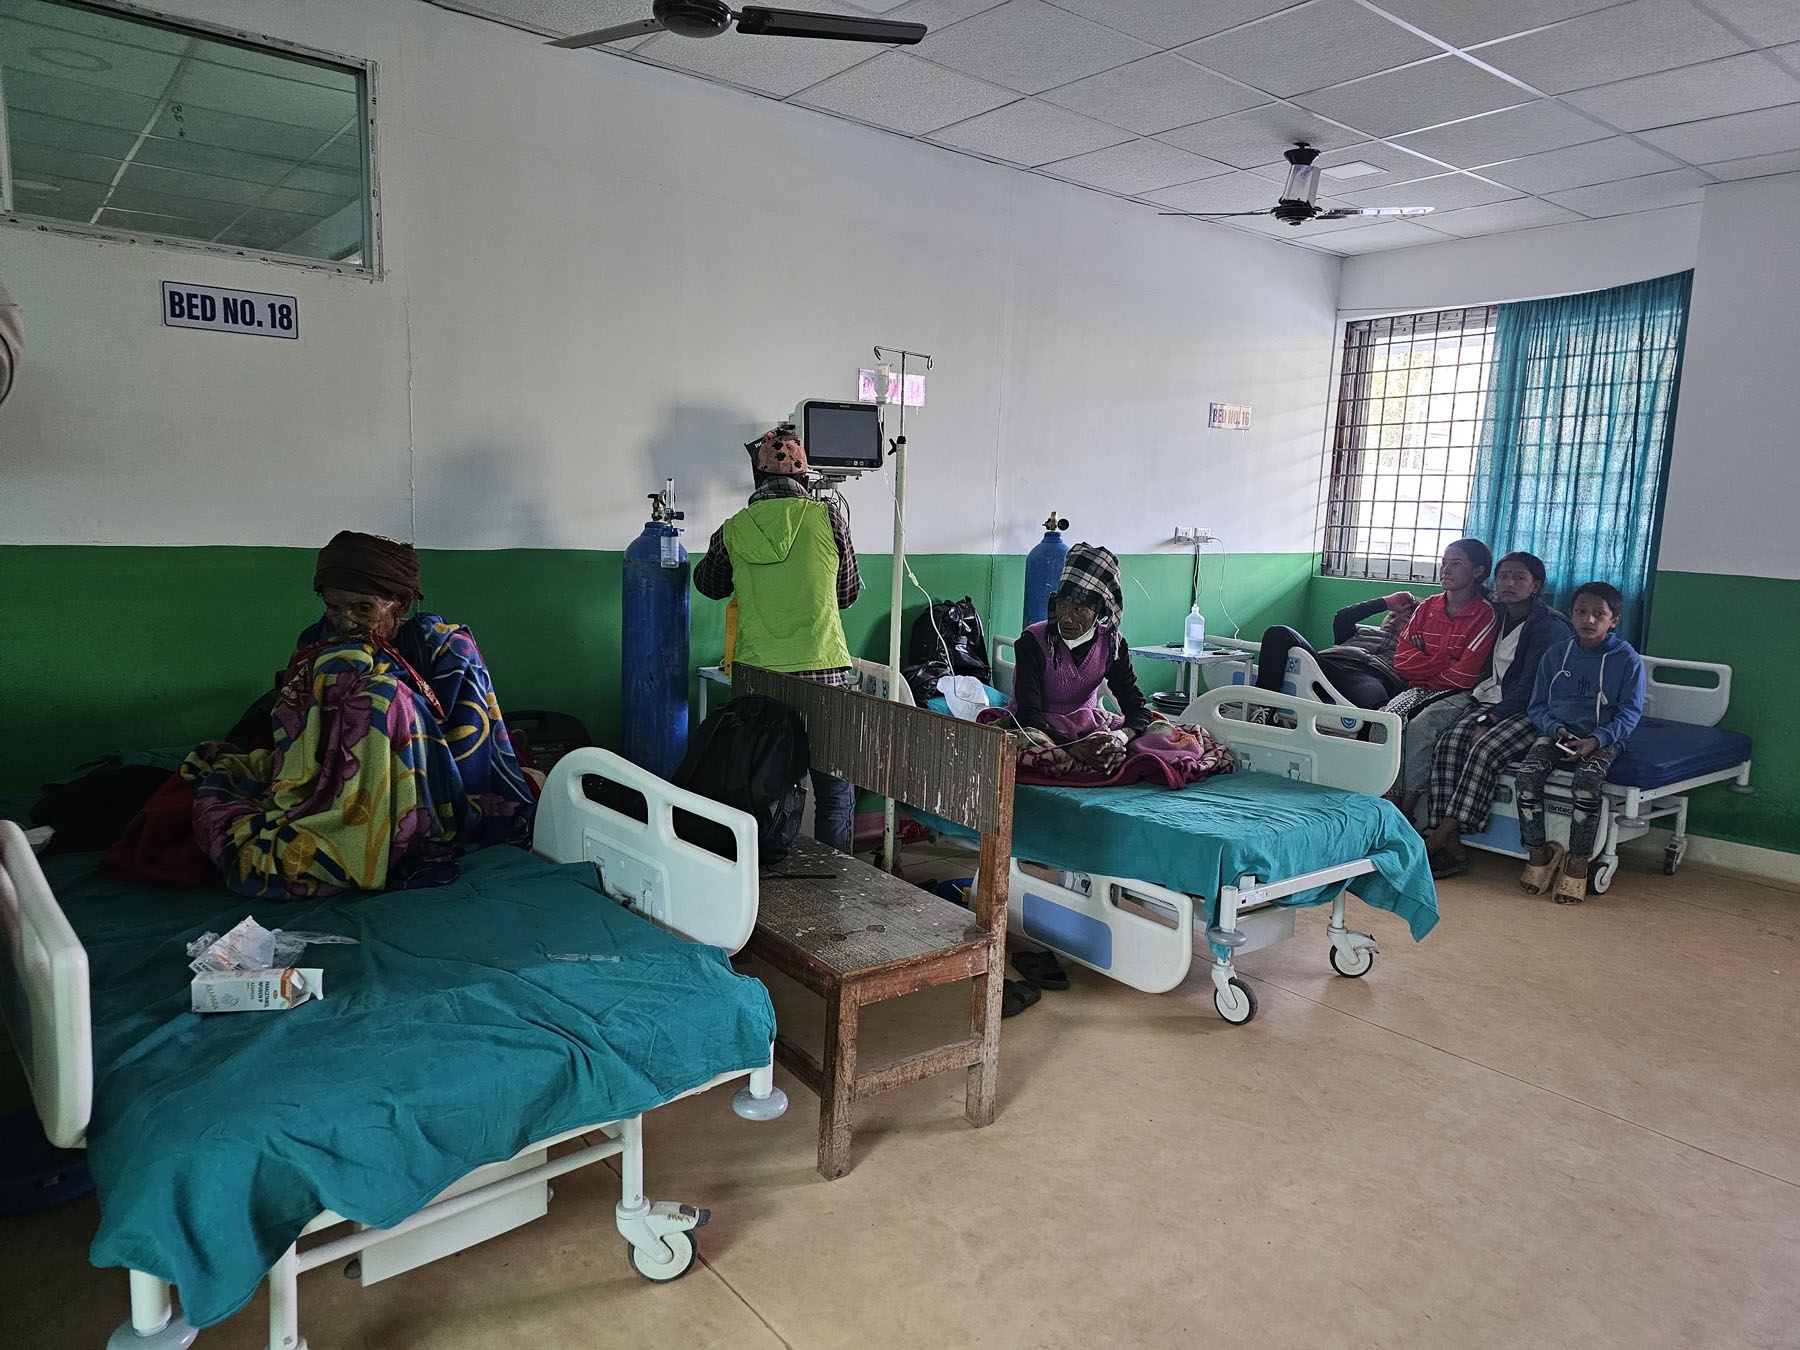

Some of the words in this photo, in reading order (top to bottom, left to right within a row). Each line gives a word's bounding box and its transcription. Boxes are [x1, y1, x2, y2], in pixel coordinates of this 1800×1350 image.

[169, 290, 216, 322] BED
[268, 302, 293, 330] 18
[1213, 408, 1226, 423] BED
